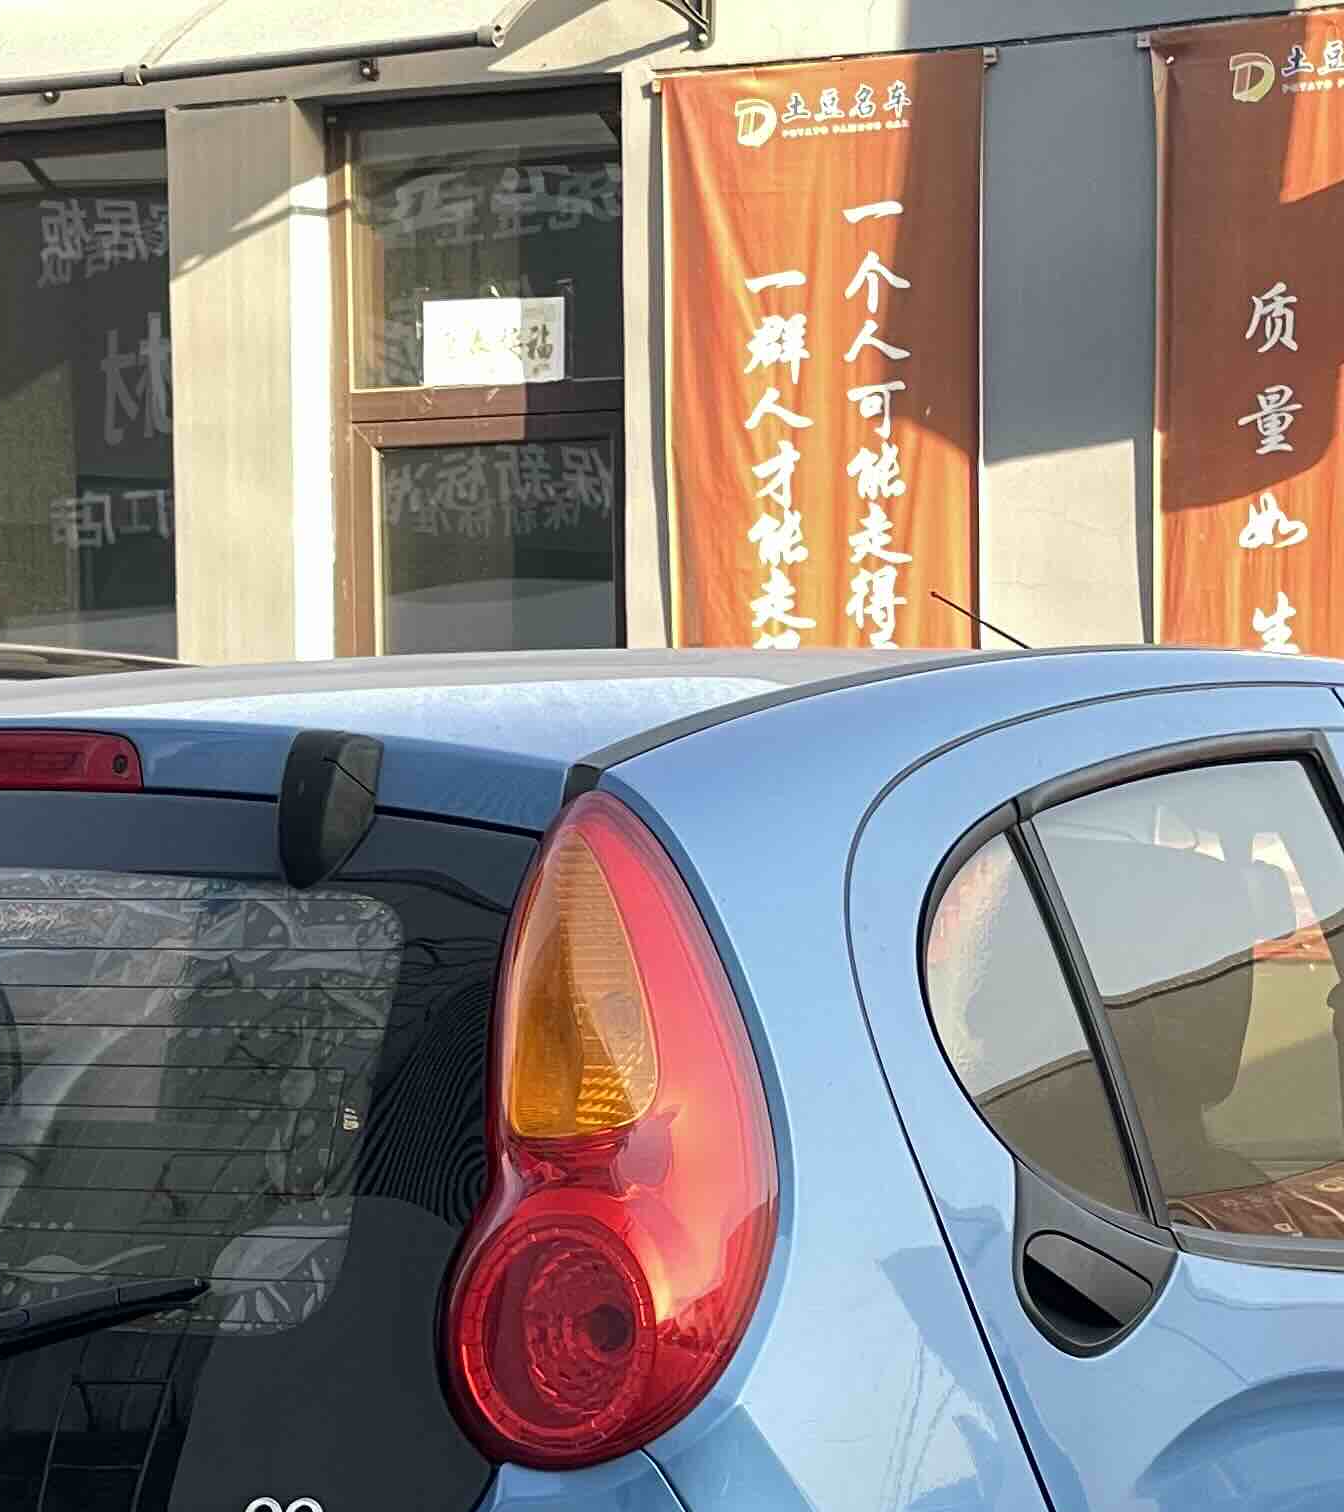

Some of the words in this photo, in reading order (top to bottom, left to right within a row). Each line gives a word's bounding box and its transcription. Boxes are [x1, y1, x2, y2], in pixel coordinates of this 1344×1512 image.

[782, 80, 912, 122] 土豆名车
[843, 200, 913, 648] 一个人可能走得
